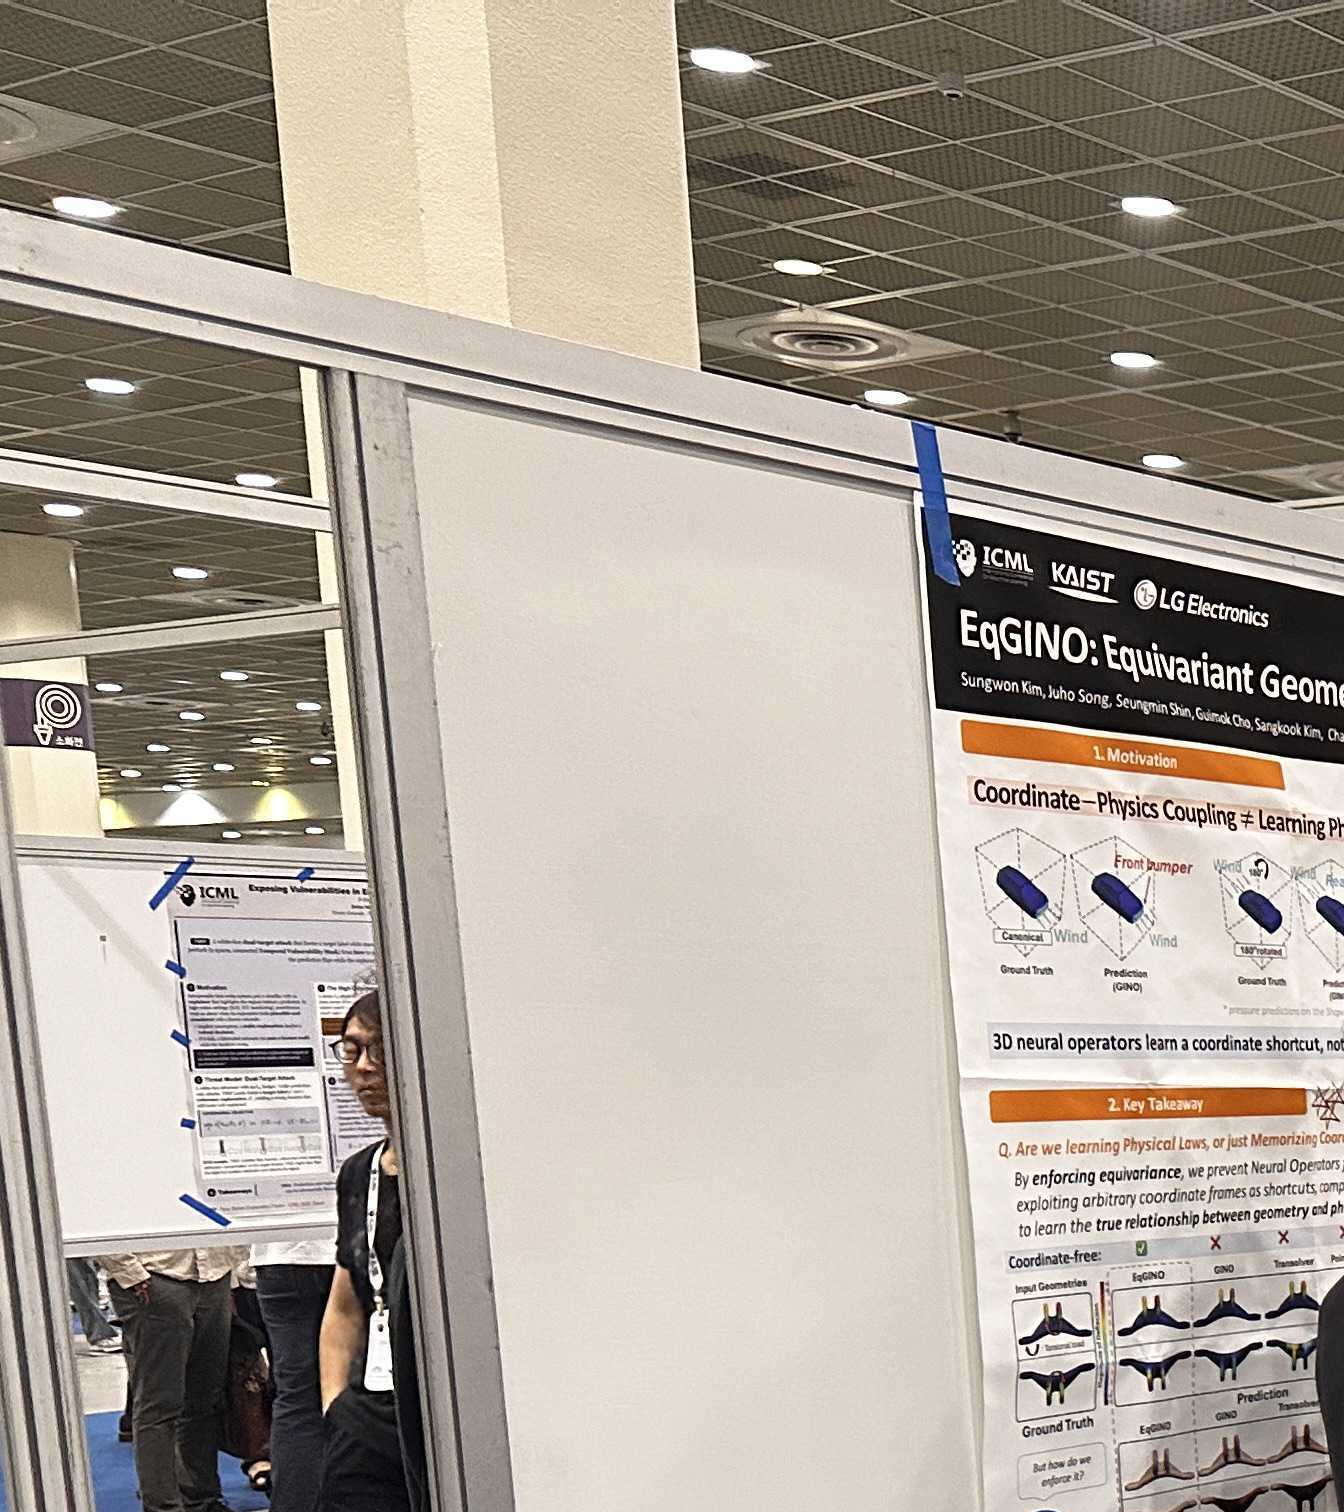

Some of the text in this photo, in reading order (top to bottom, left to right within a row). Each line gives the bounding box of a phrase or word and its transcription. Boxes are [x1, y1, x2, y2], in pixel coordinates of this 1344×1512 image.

[983, 546, 1034, 573] ICML
[1051, 562, 1115, 593] KAIST
[1160, 588, 1270, 628] LG Electronics
[960, 608, 1098, 666] EqGINO:
[1103, 634, 1254, 695] Equivariant
[961, 672, 1019, 693] Sungwon
[1022, 679, 1046, 698] Kim,
[1048, 685, 1075, 702] Juho
[1078, 689, 1112, 709] Song,
[1116, 694, 1168, 716] Seungmin
[1170, 702, 1194, 720] Shin,
[1255, 718, 1301, 737] Sangkook
[1303, 724, 1323, 741] Kim,
[1093, 745, 1178, 769] 1. Motivation
[1162, 799, 1238, 831] Coupling
[1258, 809, 1325, 840] Learning
[1114, 855, 1193, 876] Front bumper
[200, 886, 239, 899] ICML
[248, 884, 288, 894] Exposing
[290, 885, 348, 895] Vulnerabilities
[1054, 930, 1088, 944] Wind
[1150, 934, 1178, 948] Wind
[1000, 964, 1054, 976] Ground Truth
[1104, 967, 1148, 979] Prediction
[993, 1033, 1012, 1050] 3D
[1017, 1033, 1063, 1051] neural
[1067, 1035, 1142, 1054] operators
[1146, 1033, 1177, 1051] learn
[1181, 1038, 1188, 1051] a
[1192, 1034, 1263, 1052] coordinate
[1266, 1036, 1324, 1054] shortcut,
[1109, 1097, 1203, 1113] 2. Key Takeaway
[998, 1142, 1011, 1158] Q.
[1015, 1141, 1038, 1156] Are
[1041, 1143, 1062, 1156] we
[1066, 1138, 1120, 1159] learning
[1123, 1135, 1176, 1155] Physical
[1179, 1136, 1209, 1151] Laws,
[1213, 1137, 1225, 1149] or
[1227, 1134, 1248, 1151] just
[1250, 1132, 1317, 1148] Memorizing
[1015, 1172, 1029, 1188] By
[1032, 1168, 1096, 1188] enforcing
[1100, 1165, 1185, 1185] equivariance,
[1188, 1166, 1204, 1179] we
[1207, 1162, 1248, 1179] prevent
[1251, 1159, 1287, 1175] Neural
[1290, 1157, 1340, 1175] Operators
[1017, 1193, 1078, 1214] exploiting
[1082, 1189, 1136, 1211] arbitrary
[1139, 1187, 1206, 1205] coordinate
[1208, 1183, 1247, 1203] frames
[1250, 1185, 1262, 1197] as
[1264, 1181, 1317, 1197] shortcuts,
[1019, 1222, 1031, 1237] to
[1034, 1218, 1066, 1236] learn
[1070, 1216, 1092, 1233] the
[1096, 1217, 1122, 1231] true
[1125, 1210, 1199, 1231] relationship
[1202, 1208, 1251, 1225] between
[1253, 1205, 1309, 1223] geometry
[1312, 1203, 1328, 1216] and
[1008, 1250, 1102, 1269] Coordinate-free:
[1015, 1279, 1088, 1295] Input Geometries
[1237, 1387, 1288, 1404] Prediction
[1022, 1416, 1094, 1438] Ground Truth
[1033, 1457, 1091, 1473] But how do we
